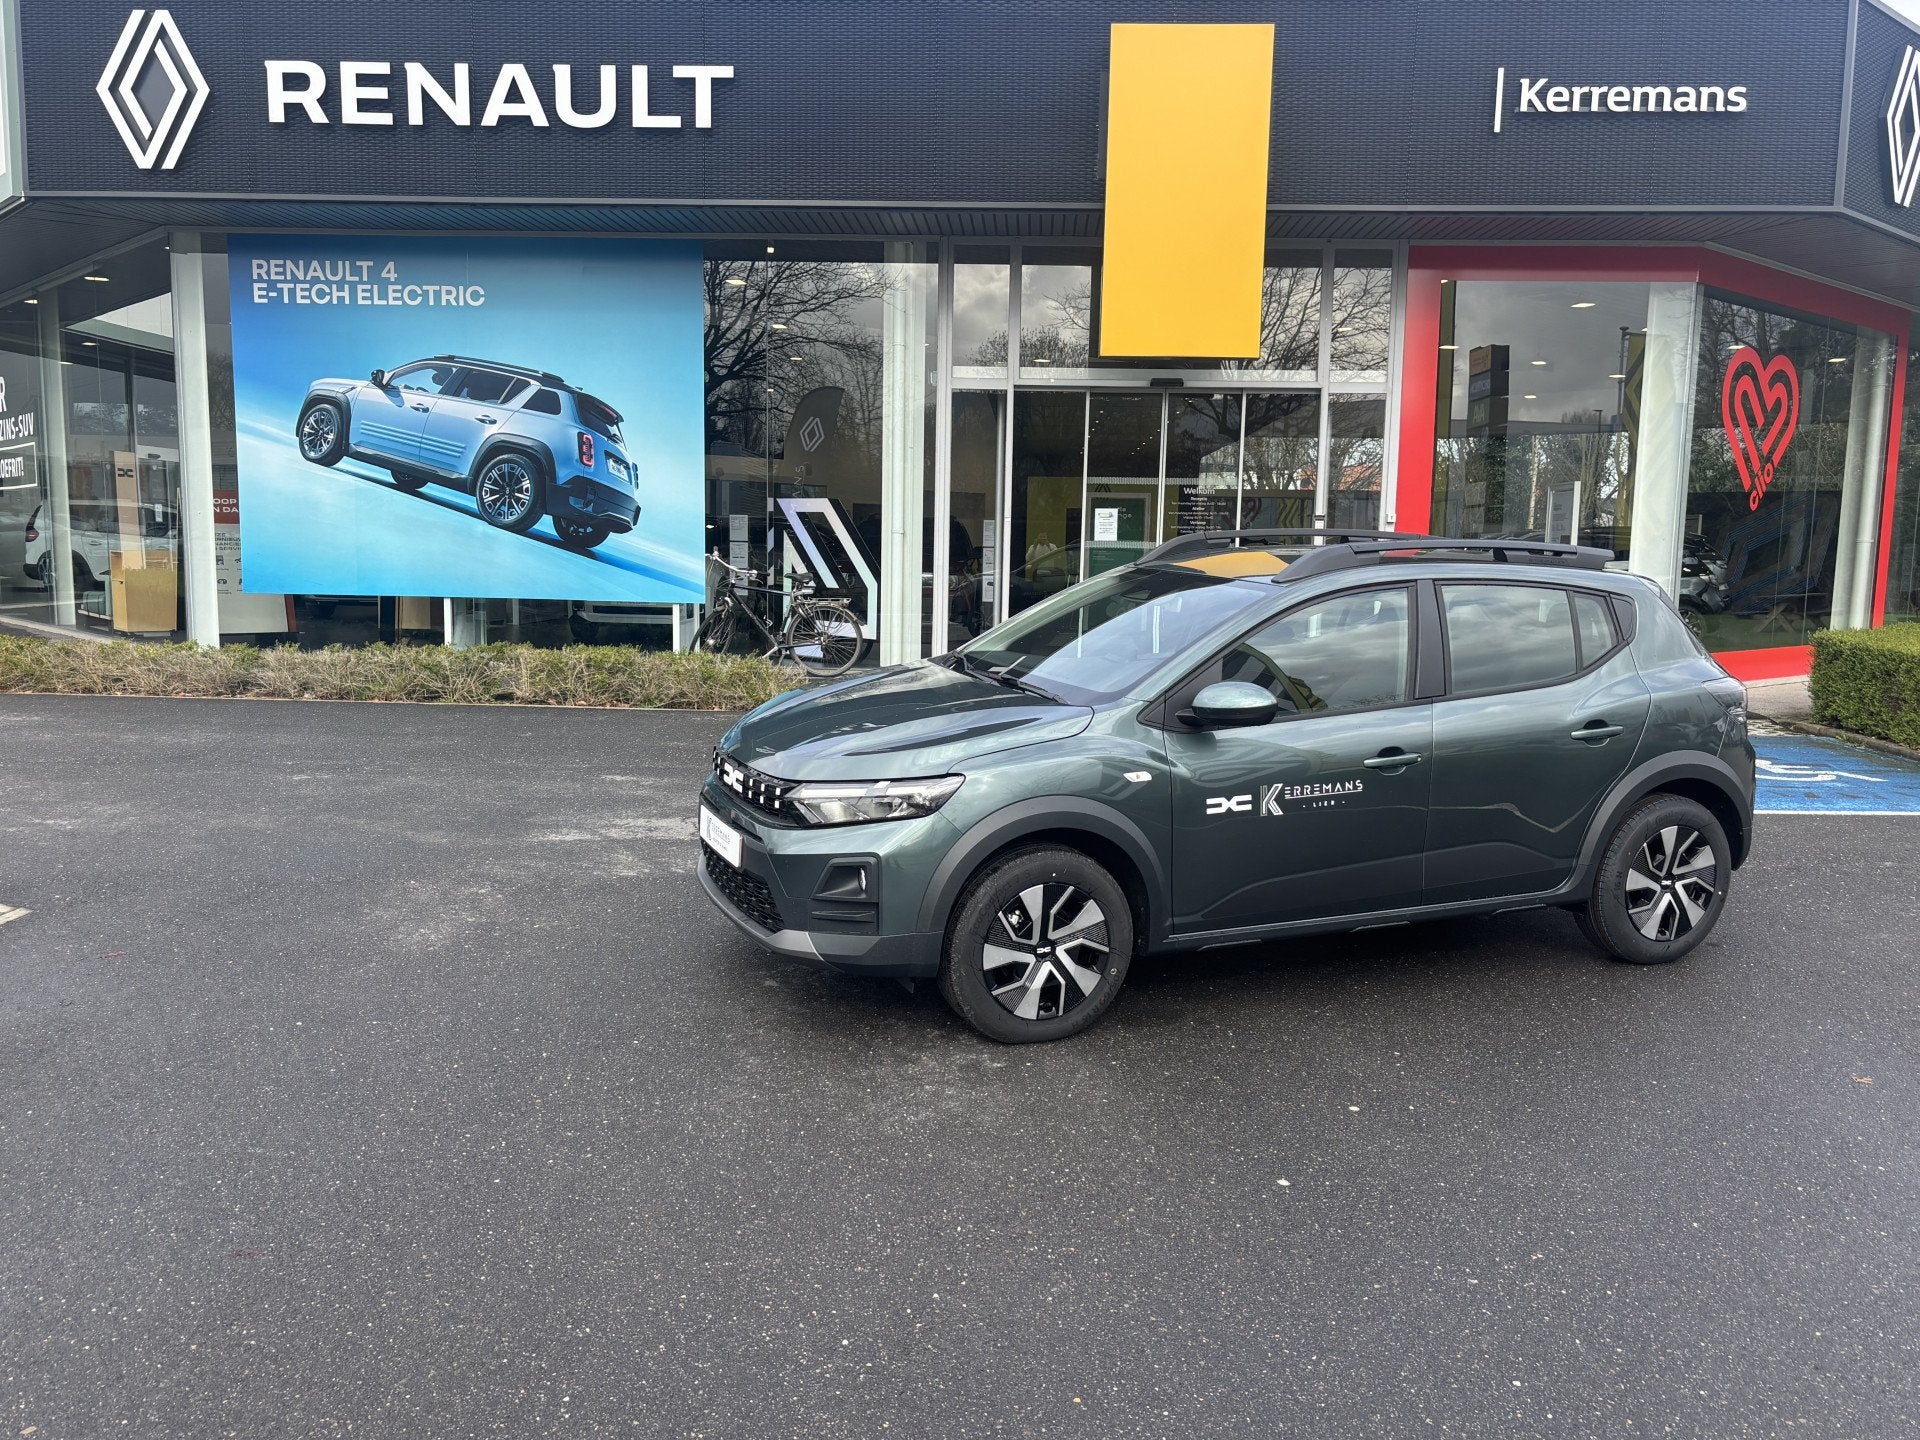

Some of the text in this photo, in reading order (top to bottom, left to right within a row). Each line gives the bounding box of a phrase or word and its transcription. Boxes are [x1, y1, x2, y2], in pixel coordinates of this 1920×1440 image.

[264, 59, 735, 129] RENAULT
[1519, 77, 1748, 113] Kerremans
[251, 259, 398, 282] RENAULT 4
[253, 282, 486, 306] E-TECH ELECTRIC
[0, 456, 24, 479] OEFRIT!
[1749, 462, 1774, 512] clio
[1260, 779, 1363, 817] KERREMANS
